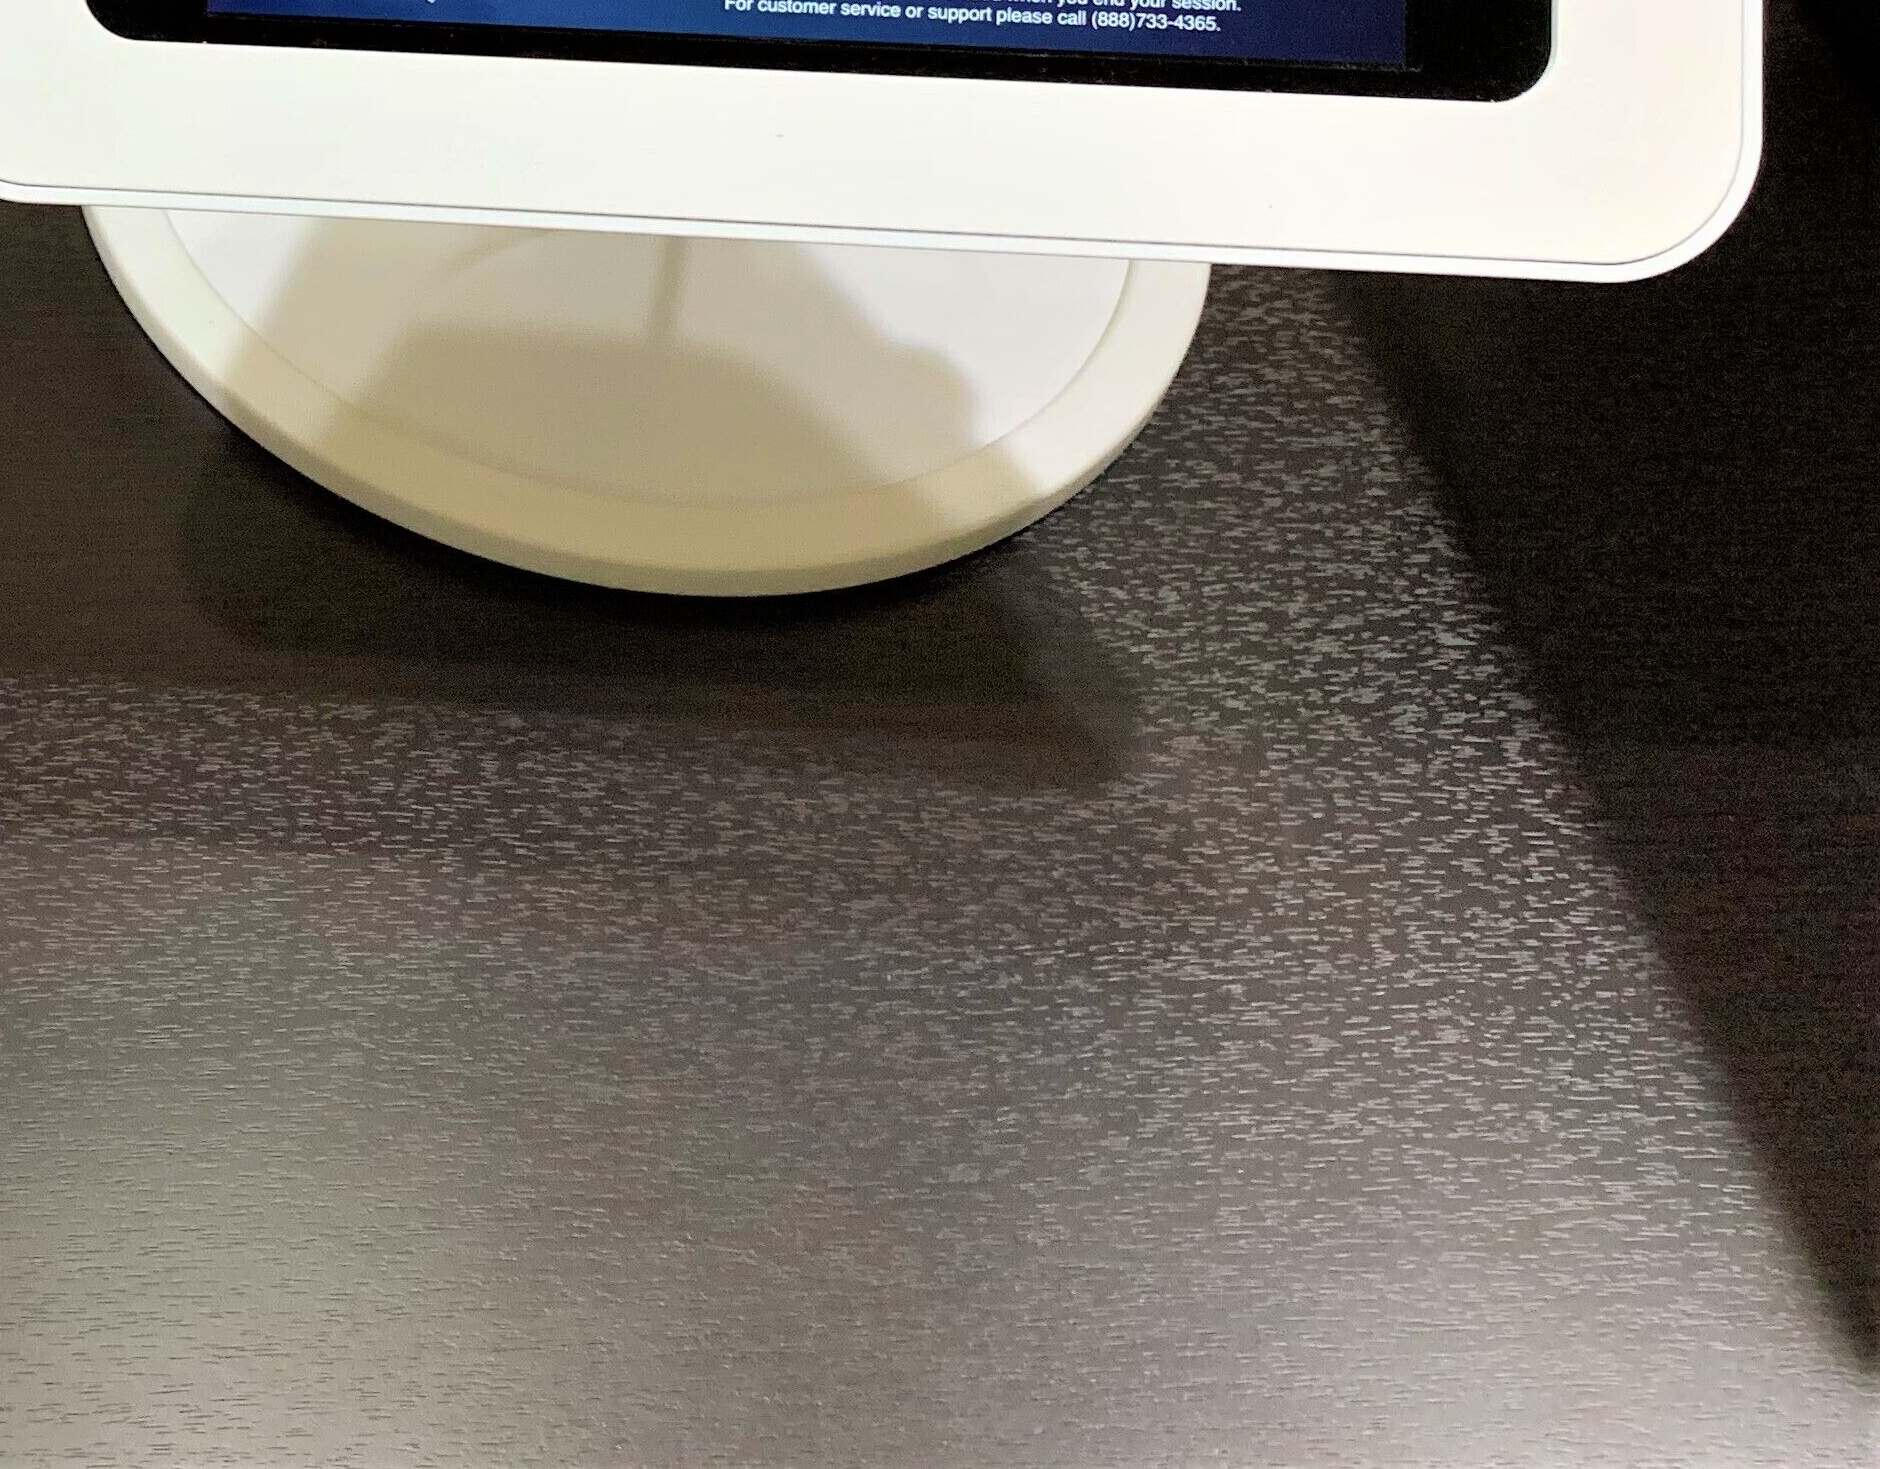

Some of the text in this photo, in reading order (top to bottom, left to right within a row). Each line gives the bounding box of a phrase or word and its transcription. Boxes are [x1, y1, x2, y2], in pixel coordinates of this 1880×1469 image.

[840, 1, 901, 18] service
[905, 6, 925, 19] or
[927, 6, 992, 24] support
[995, 8, 1053, 26] please
[1057, 9, 1087, 26] call
[1091, 11, 1222, 32] (888)733-4365.
